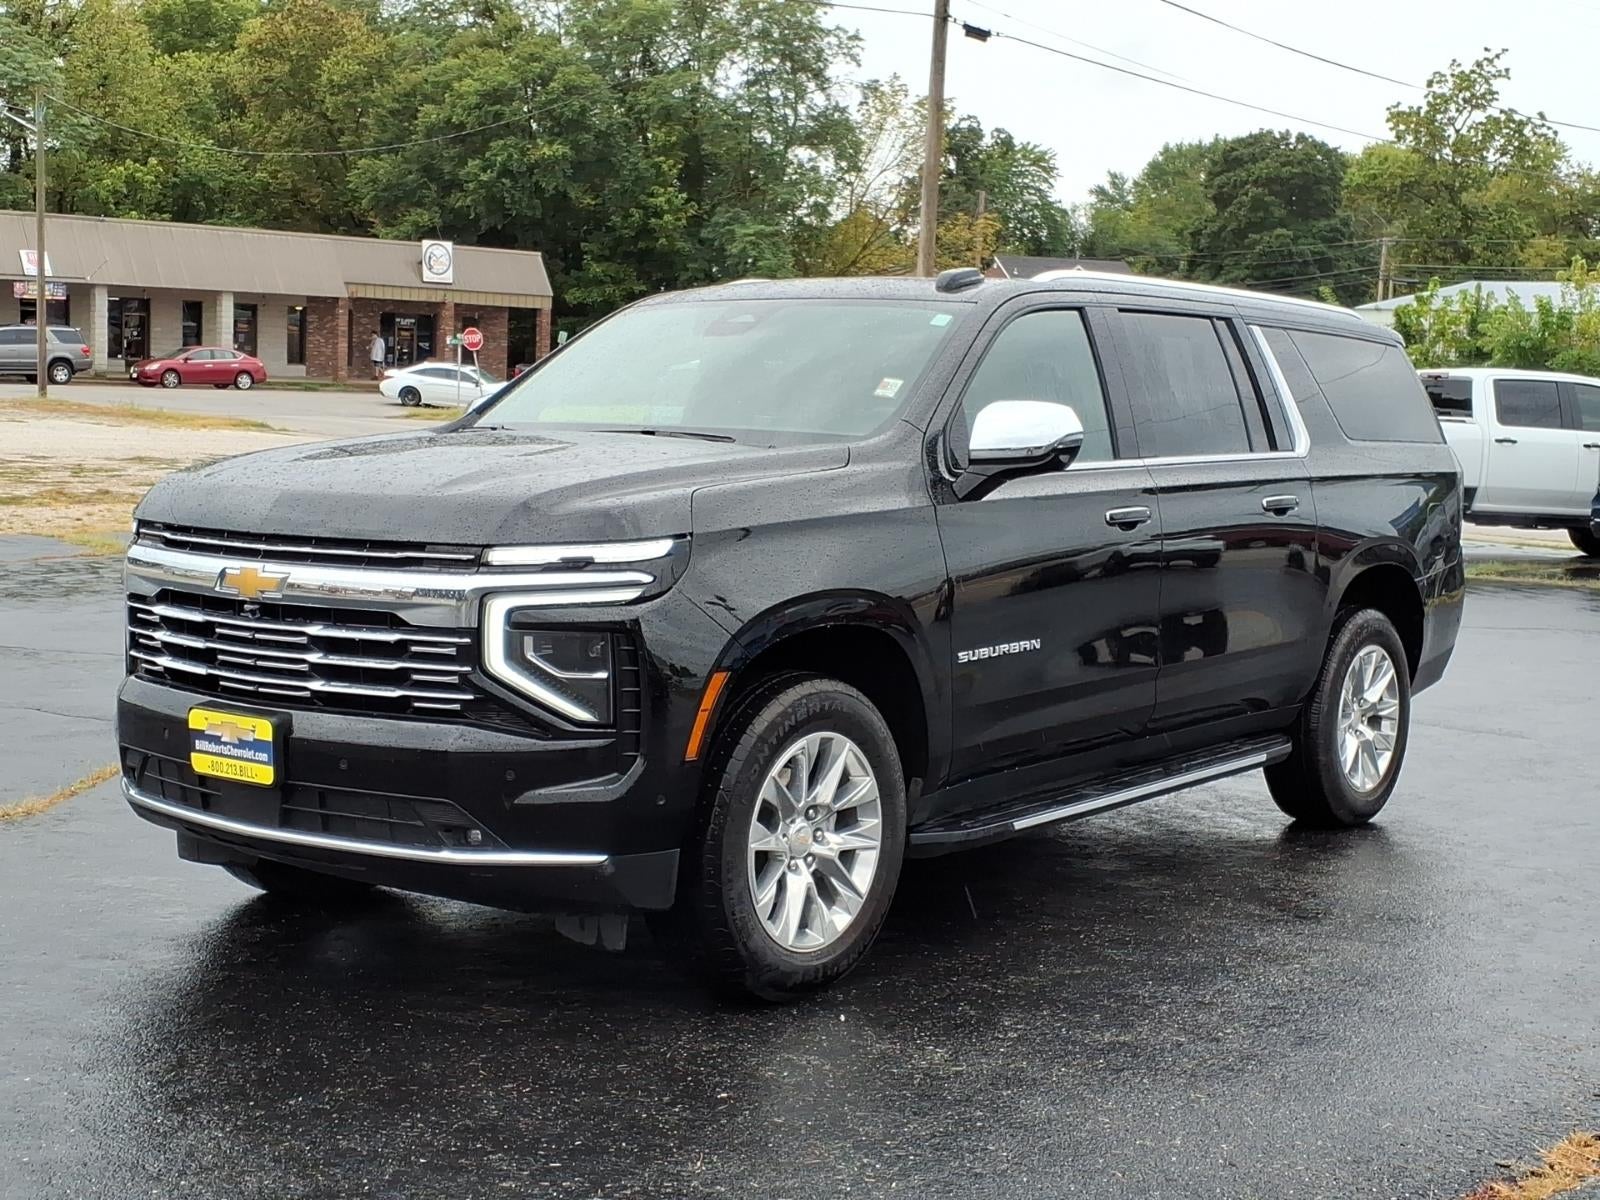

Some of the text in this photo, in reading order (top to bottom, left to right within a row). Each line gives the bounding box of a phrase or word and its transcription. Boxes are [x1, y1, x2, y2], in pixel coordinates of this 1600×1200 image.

[464, 334, 481, 344] STOP
[957, 638, 1041, 663] SUBURBAN
[195, 739, 269, 762] BillRobertsChevrolet.com
